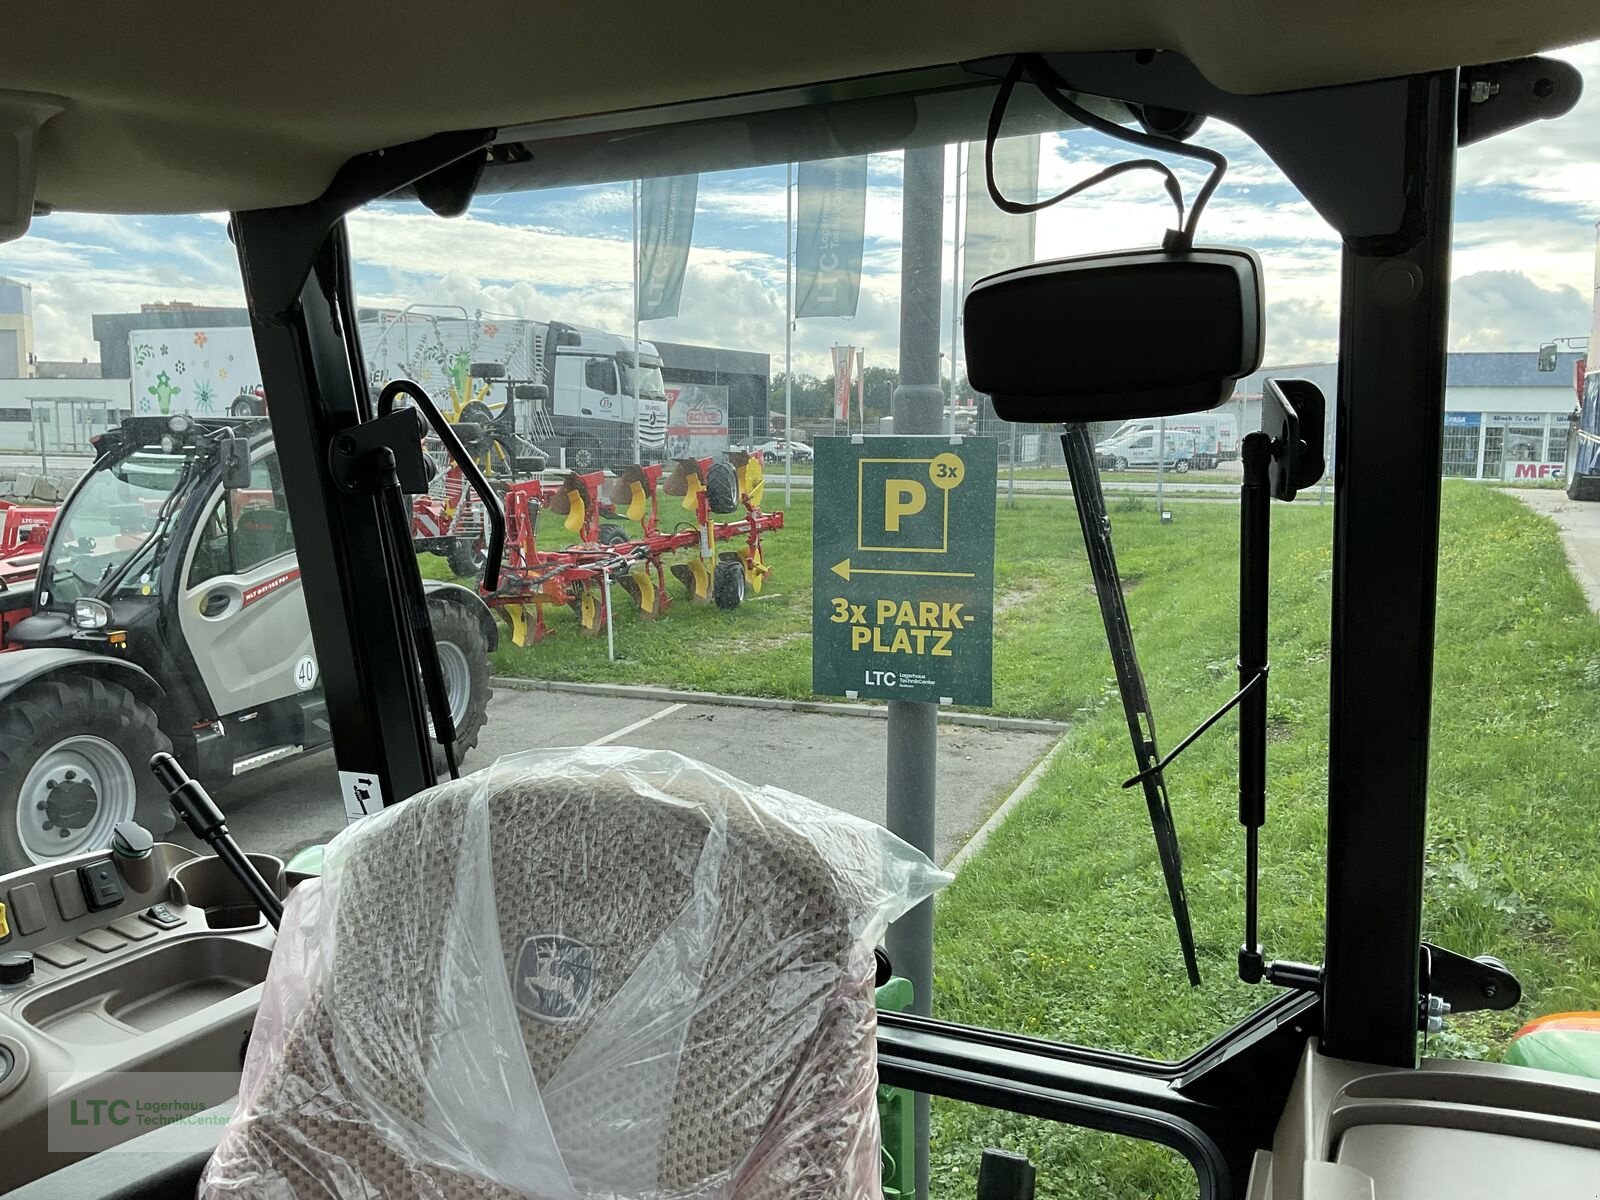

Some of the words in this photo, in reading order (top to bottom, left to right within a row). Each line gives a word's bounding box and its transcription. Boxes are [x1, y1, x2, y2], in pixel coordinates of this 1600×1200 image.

[647, 261, 669, 307] LTC
[816, 252, 839, 303] LTC
[936, 463, 958, 479] 3x
[884, 478, 927, 532] P
[830, 597, 867, 624] 3x
[876, 600, 975, 629] PARK-
[851, 626, 954, 657] PLATZ
[299, 661, 313, 683] 40
[865, 670, 897, 687] LTC
